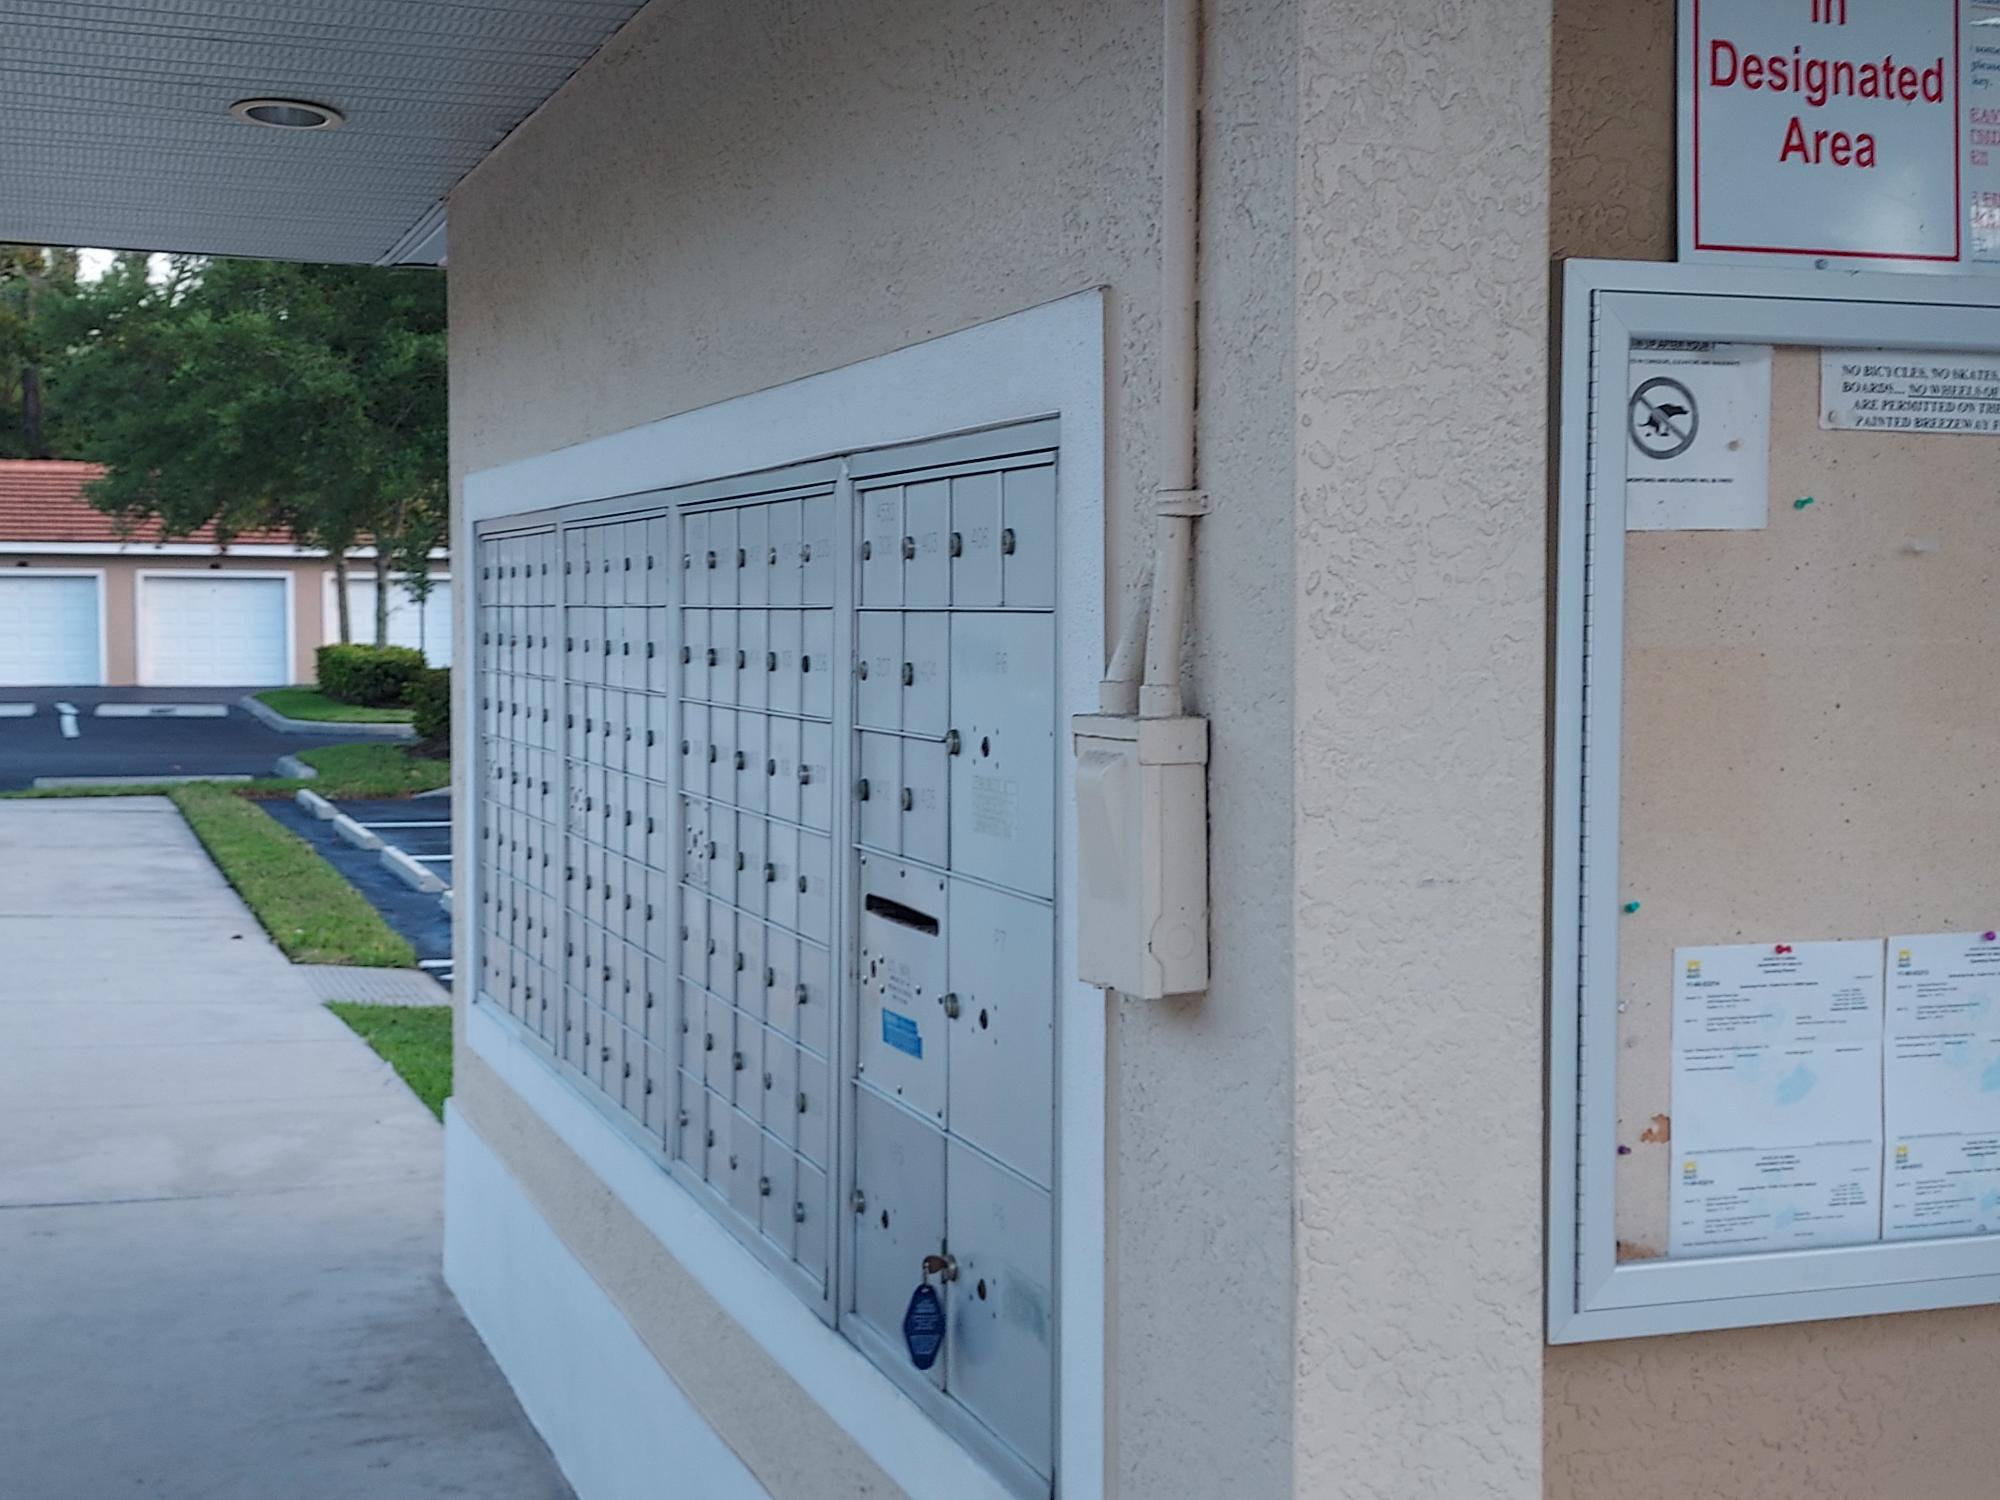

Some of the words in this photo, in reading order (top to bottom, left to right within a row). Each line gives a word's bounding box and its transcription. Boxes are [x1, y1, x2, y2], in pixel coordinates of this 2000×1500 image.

[1710, 39, 1945, 107] Designated
[1779, 116, 1876, 169] Area
[1881, 400, 1956, 413] PERMITTED
